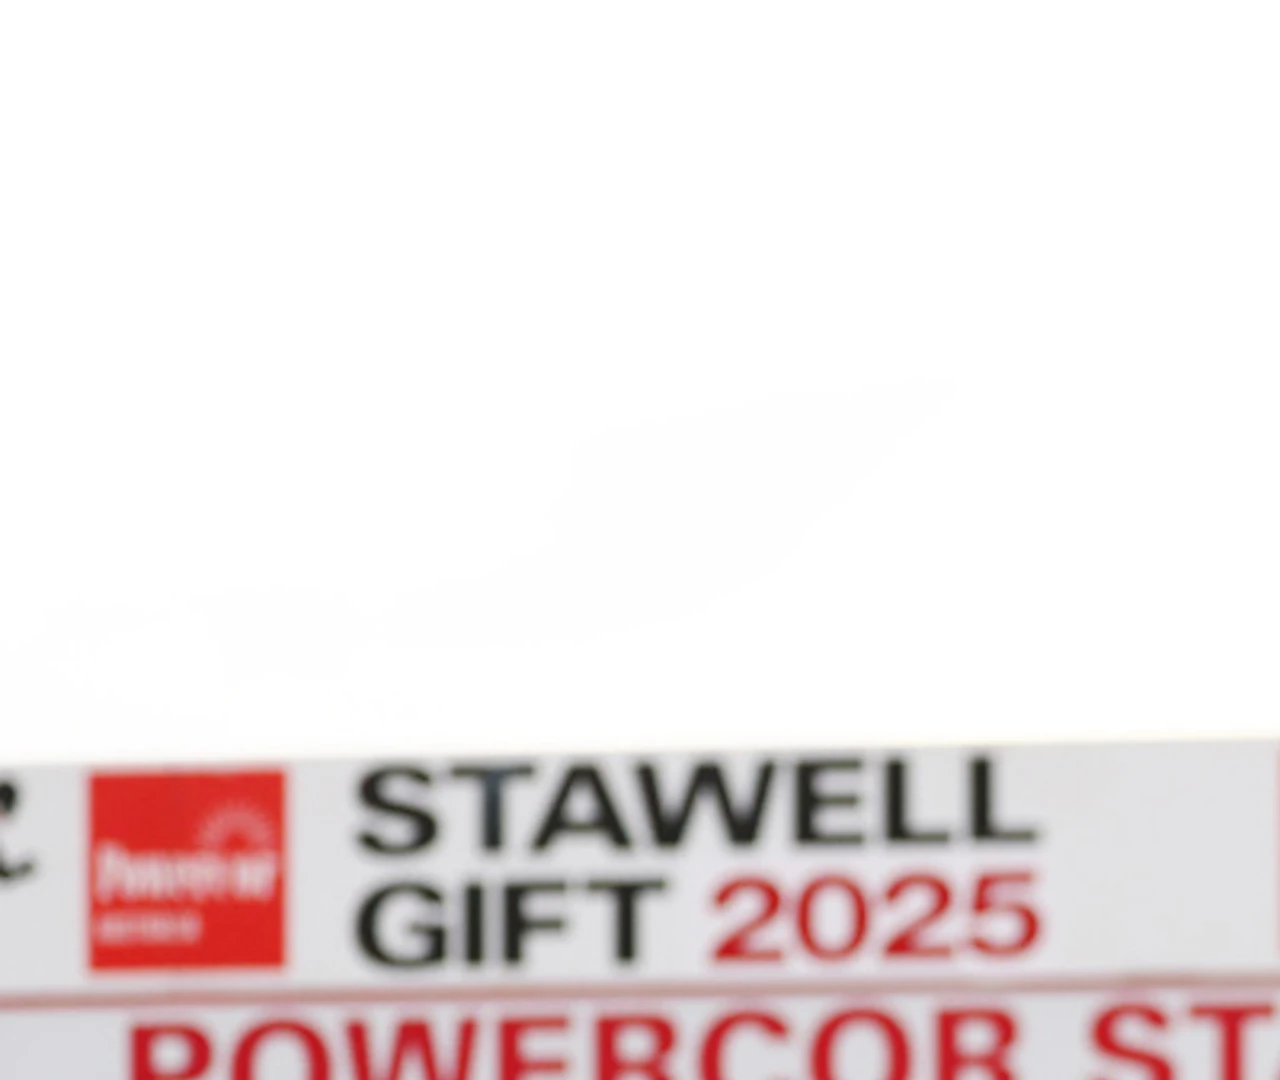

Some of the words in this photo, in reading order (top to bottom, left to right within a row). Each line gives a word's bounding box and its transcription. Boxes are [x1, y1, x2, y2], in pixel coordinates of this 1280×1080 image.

[355, 755, 1036, 856] STAWELL
[353, 879, 667, 969] GIFT
[712, 872, 1042, 963] 2025
